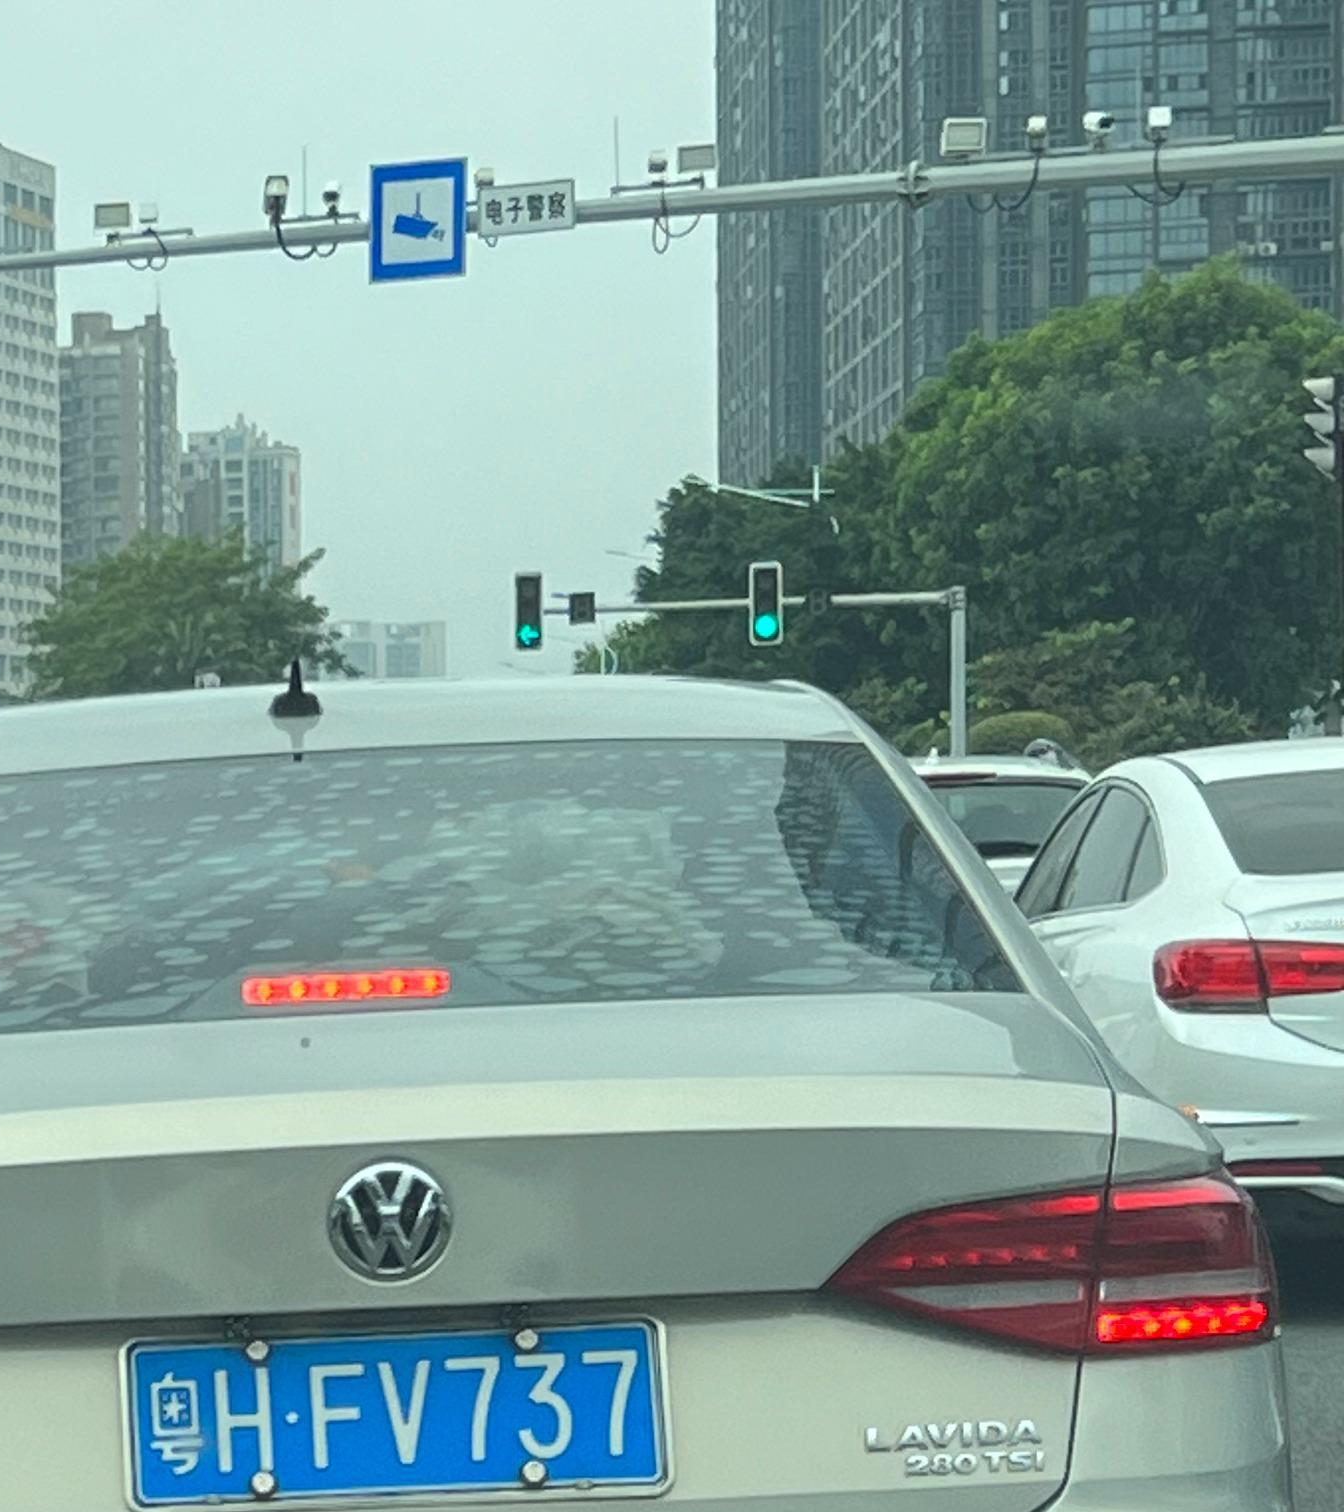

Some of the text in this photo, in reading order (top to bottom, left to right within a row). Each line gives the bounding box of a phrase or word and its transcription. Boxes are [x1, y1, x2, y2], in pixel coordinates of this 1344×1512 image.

[485, 191, 566, 226] 电子警察
[864, 1419, 1043, 1453] LAVIDA
